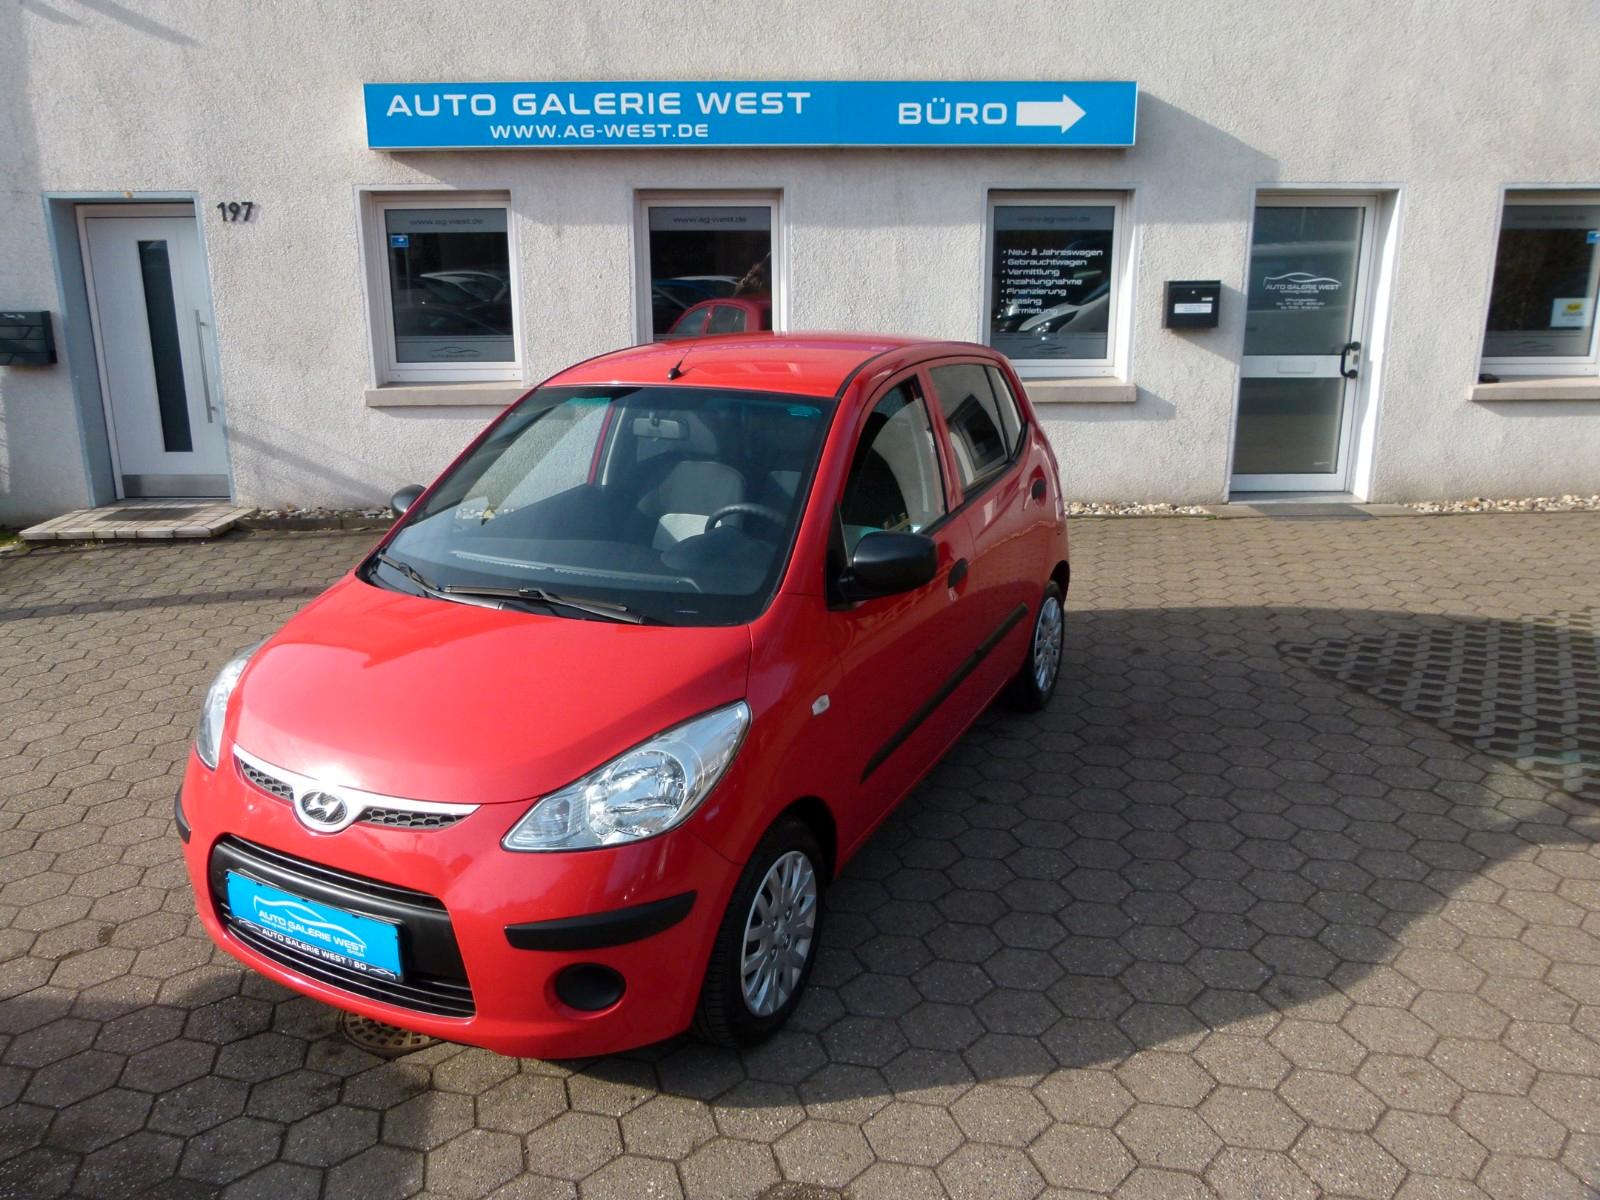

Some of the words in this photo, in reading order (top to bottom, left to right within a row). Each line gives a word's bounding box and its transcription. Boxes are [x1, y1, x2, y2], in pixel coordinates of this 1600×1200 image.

[386, 93, 497, 117] AUTO
[512, 92, 682, 116] GALERIE
[697, 91, 811, 115] WEST
[898, 97, 1007, 125] BÜRO
[490, 123, 709, 139] WWW.AG-WEST.DE
[216, 201, 254, 222] 197
[1008, 248, 1030, 256] Neu-
[1040, 249, 1103, 257] Jahreswagen
[1007, 258, 1087, 266] Gebrauchtwagen
[1007, 268, 1060, 277] Vermittlung
[1006, 278, 1082, 286] Inzahlungnahme
[1006, 287, 1067, 296] Finanzierung
[1006, 297, 1042, 306] Leasing
[258, 909, 287, 927] AUTO
[287, 920, 332, 942] GALERIE
[333, 935, 367, 953] WEST
[262, 928, 284, 942] AUTO
[285, 937, 320, 955] GALERIE
[321, 950, 346, 964] WEST
